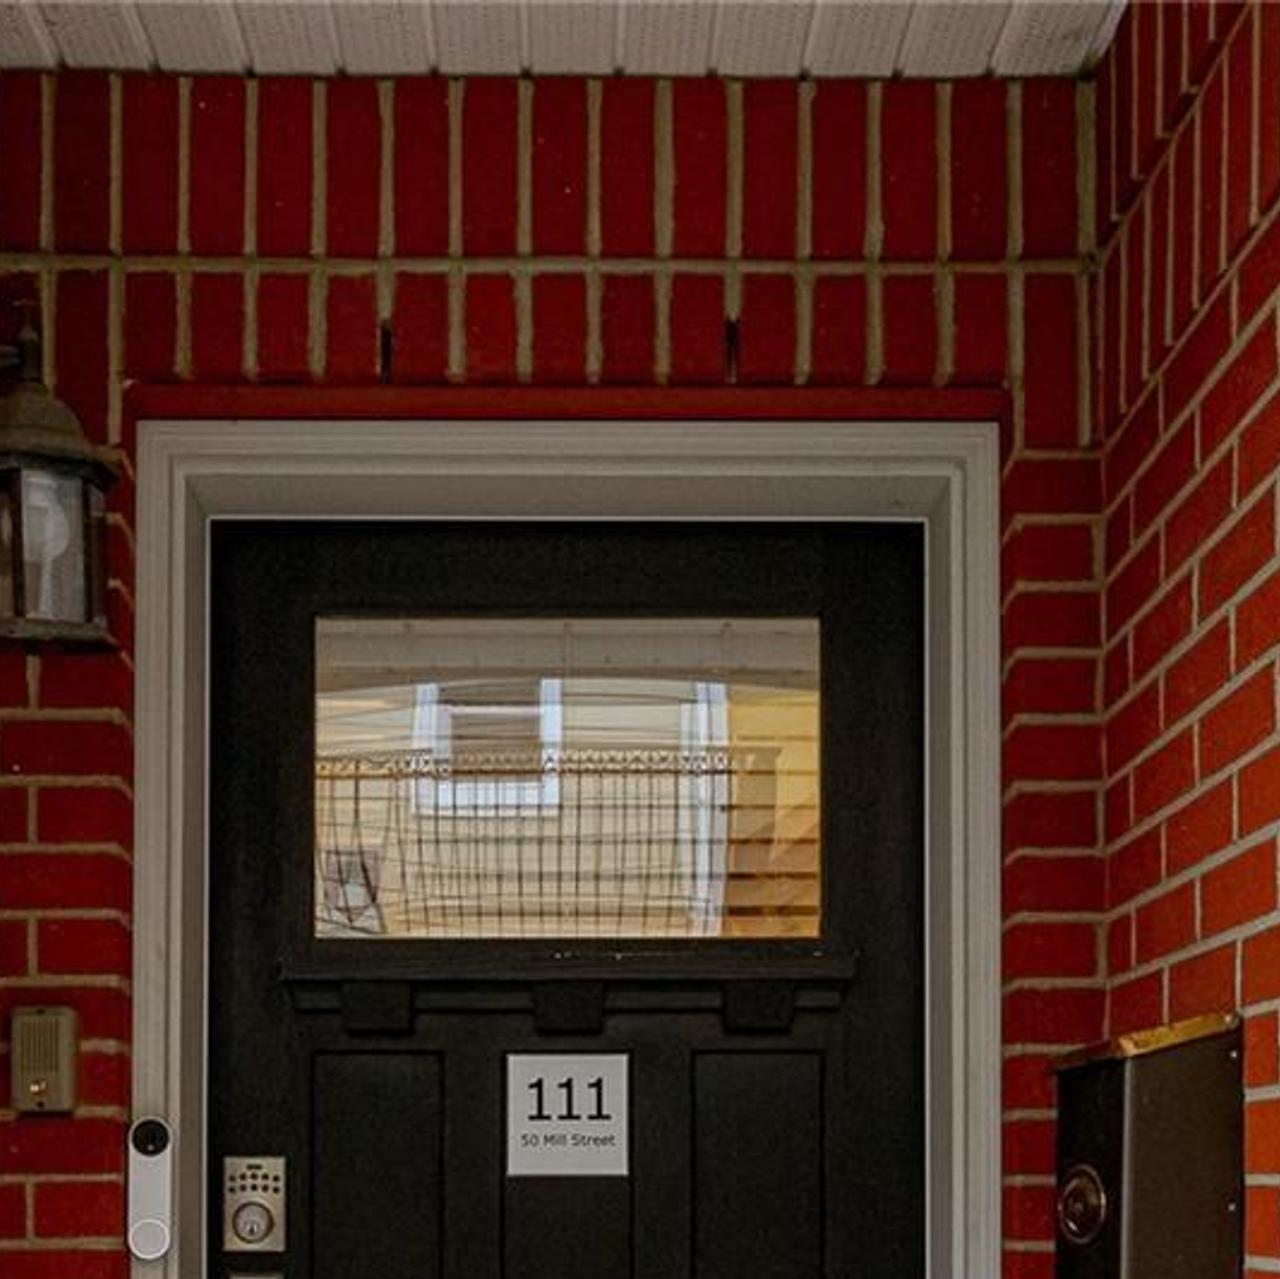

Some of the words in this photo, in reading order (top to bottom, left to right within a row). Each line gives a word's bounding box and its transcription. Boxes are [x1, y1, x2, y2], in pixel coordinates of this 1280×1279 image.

[527, 1076, 612, 1121] 111
[520, 1133, 540, 1147] 50
[543, 1133, 567, 1147] Mill
[570, 1133, 617, 1147] Street
